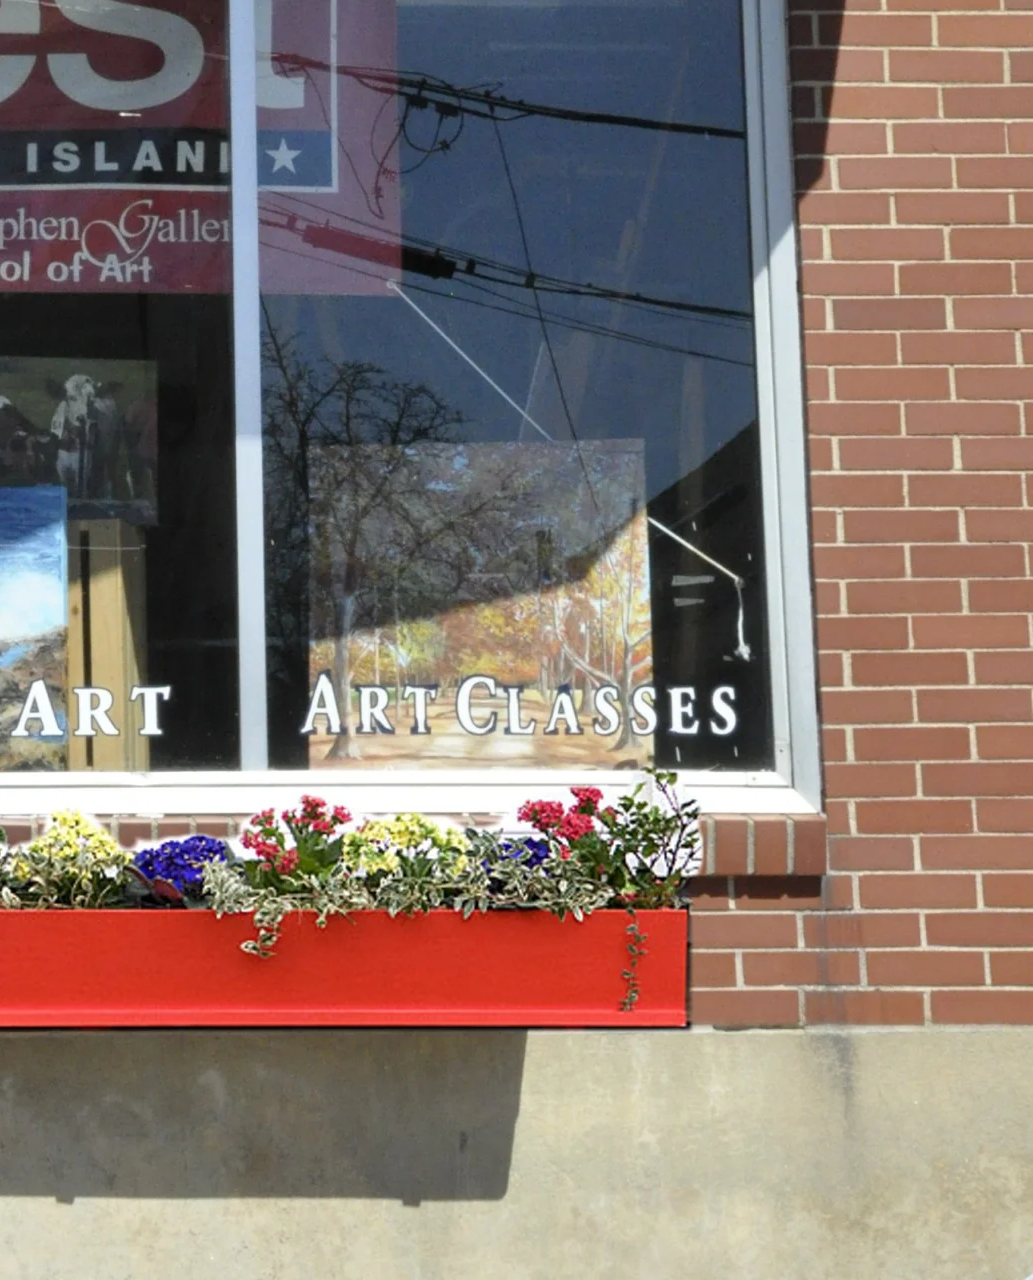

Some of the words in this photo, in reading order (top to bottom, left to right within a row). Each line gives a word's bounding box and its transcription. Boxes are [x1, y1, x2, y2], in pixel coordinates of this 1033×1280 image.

[47, 253, 85, 283] of
[99, 253, 153, 284] Art
[11, 677, 172, 737] ART
[299, 670, 439, 736] ART
[455, 673, 738, 736] CLASSES
